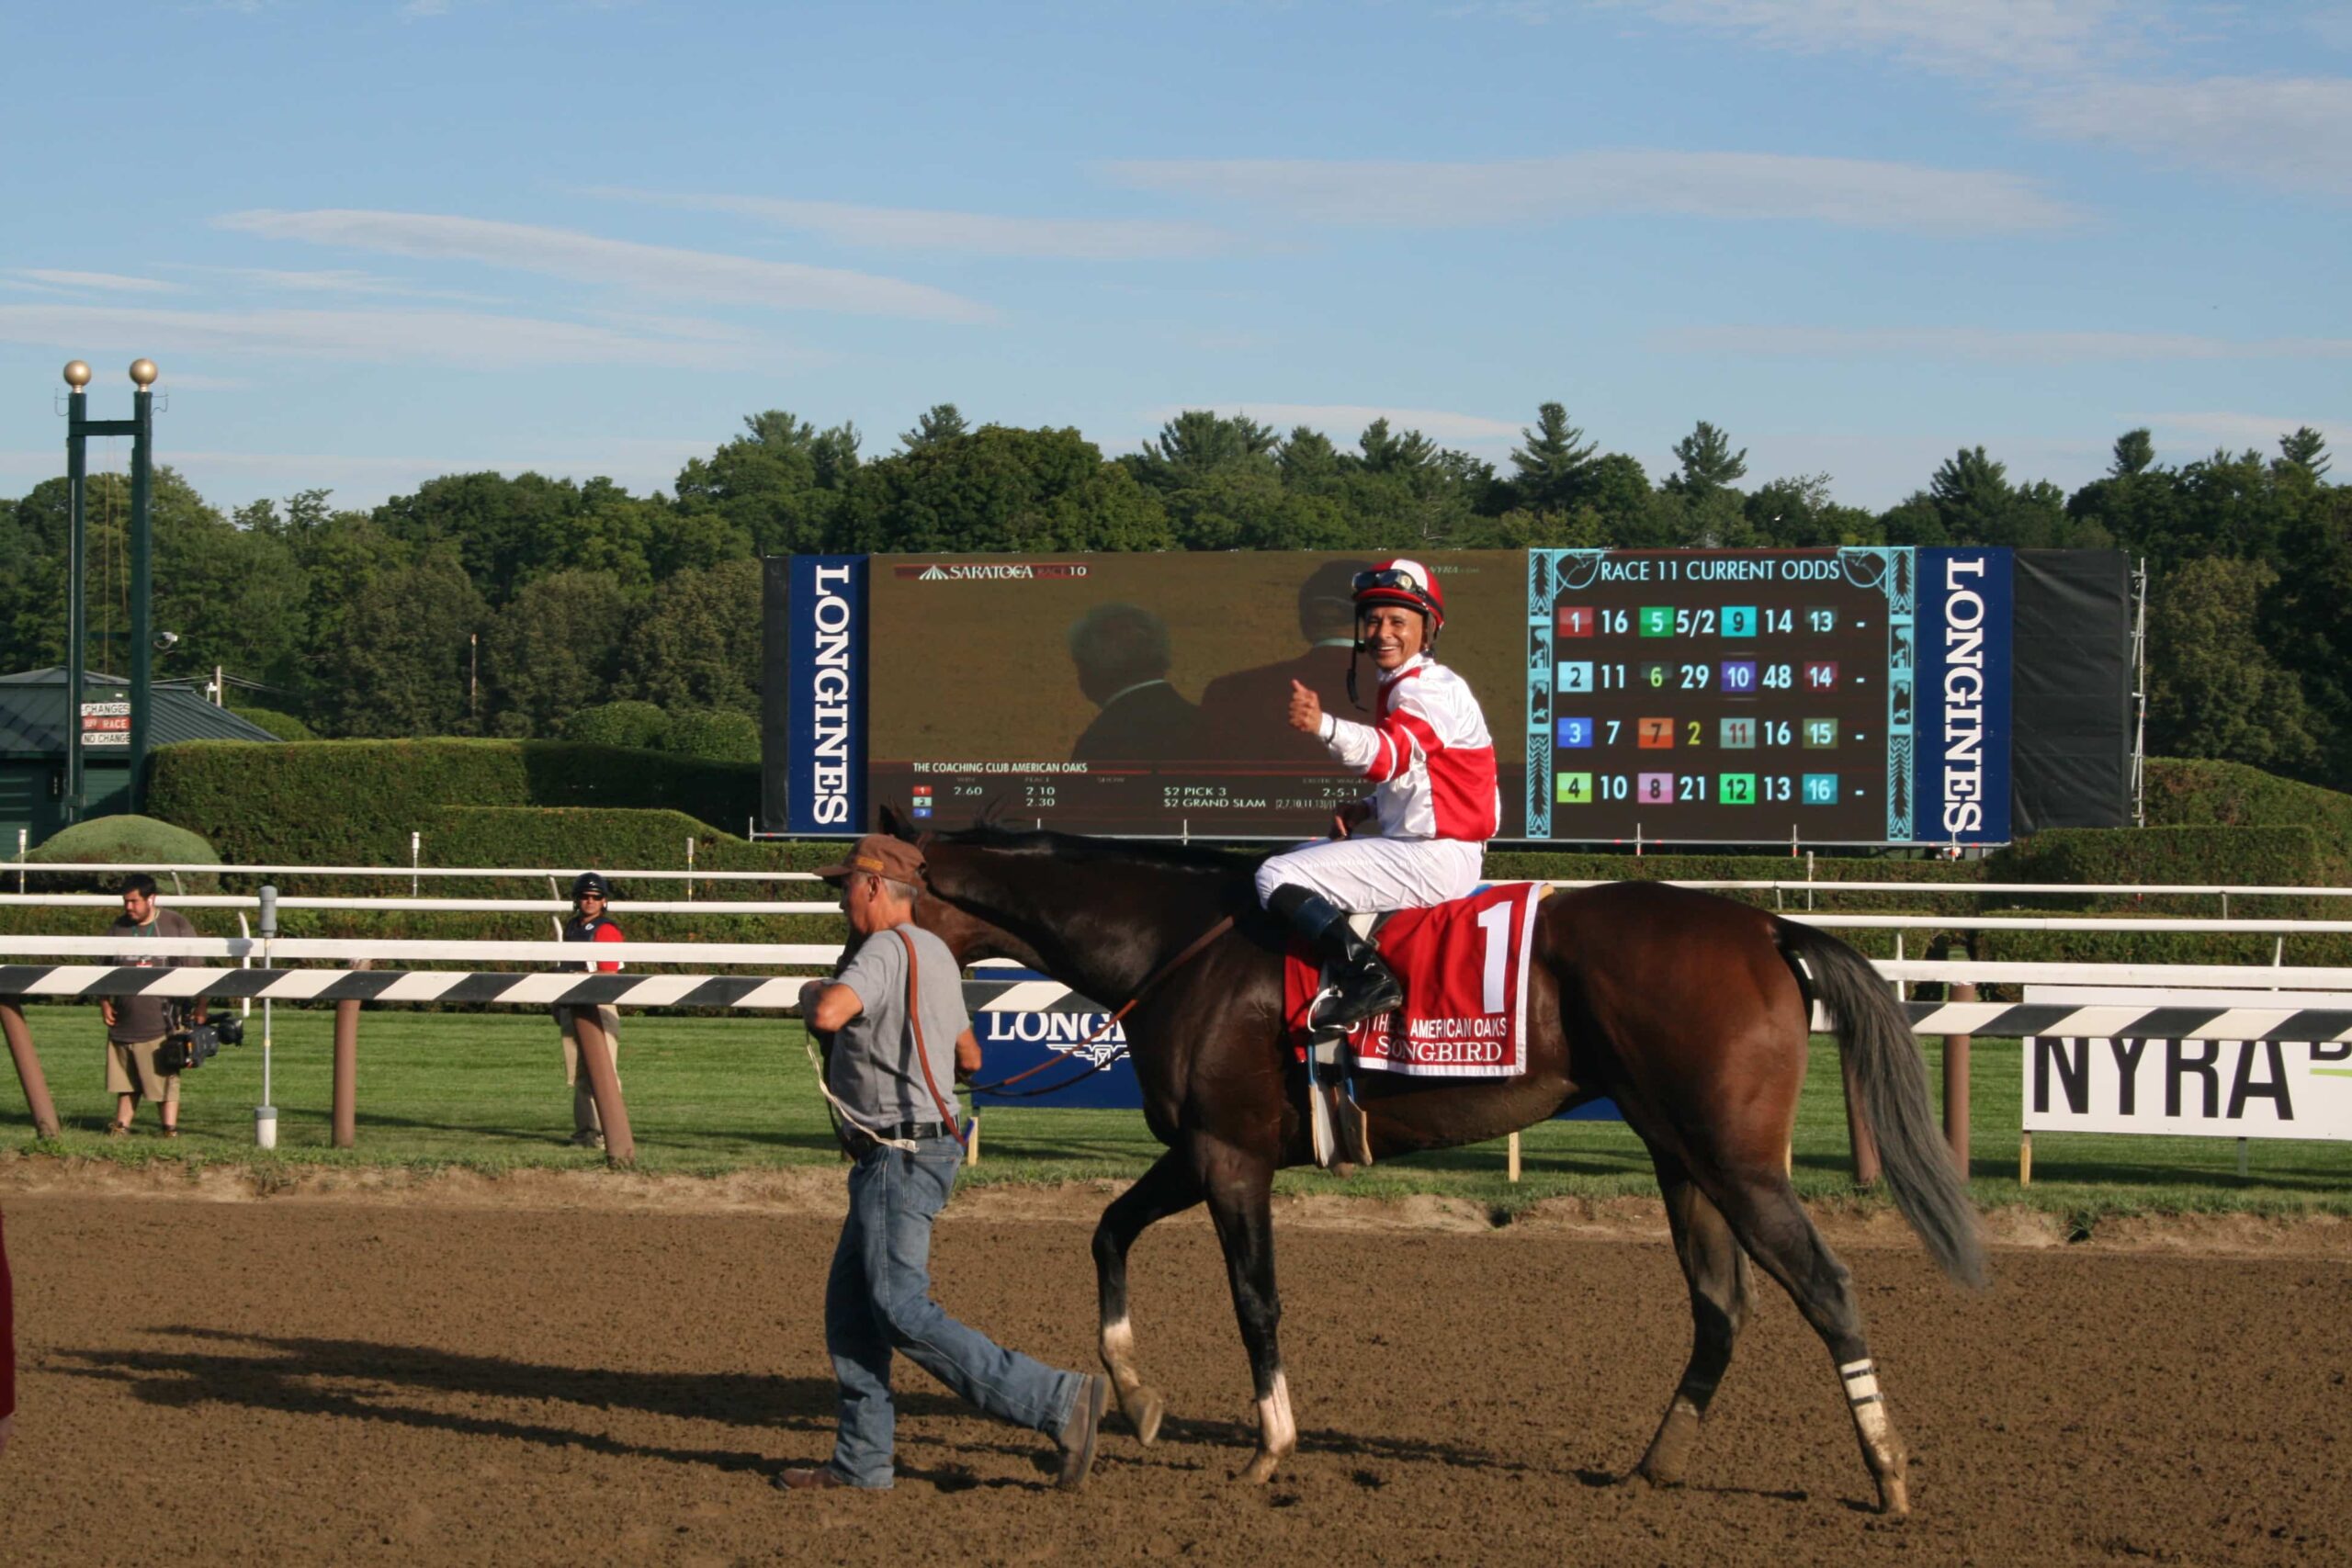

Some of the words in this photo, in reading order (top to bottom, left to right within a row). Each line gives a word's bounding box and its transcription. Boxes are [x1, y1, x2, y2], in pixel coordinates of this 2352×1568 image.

[949, 565, 1034, 580] SARATOGA
[1069, 565, 1088, 576] 10
[1600, 560, 1650, 581] RACE
[1658, 560, 1678, 581] 11
[1686, 559, 1776, 581] CURRENT
[1781, 559, 1840, 581] ODDS
[1571, 612, 1580, 632] 1
[1601, 610, 1628, 634] 16
[1651, 612, 1664, 632] 5
[1676, 610, 1715, 637] 5/2
[1732, 612, 1745, 632] 9
[1766, 610, 1793, 634] 14
[1811, 612, 1833, 632] 13
[1569, 667, 1582, 686] 2
[1601, 665, 1625, 688] 11
[1650, 667, 1663, 686] 6
[1680, 665, 1710, 688] 29
[1728, 667, 1749, 686] 10
[1762, 665, 1792, 688] 48
[1810, 667, 1832, 686] 14
[814, 565, 850, 825] LONGINES
[1942, 557, 1984, 833] LONGINES
[85, 704, 130, 714] CHANGES
[102, 719, 127, 729] RACE
[1569, 723, 1581, 743] 3
[1606, 721, 1621, 745] 7
[1650, 723, 1662, 743] 7
[1687, 721, 1702, 745] 2
[1729, 723, 1747, 743] 11
[1764, 721, 1792, 745] 16
[1809, 723, 1832, 743] 15
[84, 733, 96, 743] NO
[912, 762, 931, 773] THE
[932, 762, 984, 773] COACHING
[985, 762, 1010, 773] CLUB
[1011, 762, 1060, 773] AMERICAN
[1061, 762, 1088, 773] OAKS
[953, 786, 983, 795] 2.60
[1025, 786, 1056, 795] 2.10
[1163, 786, 1180, 796] $2
[1183, 786, 1214, 796] PICK
[1218, 786, 1227, 796] 3
[1322, 787, 1358, 797] 2-5-1
[1567, 778, 1580, 798] 4
[1600, 776, 1628, 800] 10
[1649, 778, 1661, 798] 8
[1679, 776, 1705, 800] 21
[1726, 778, 1747, 798] 12
[1764, 776, 1792, 800] 13
[1808, 778, 1831, 798] 16
[1025, 797, 1056, 807] 2.30
[1163, 798, 1179, 808] $2
[1182, 798, 1229, 807] GRAND
[1233, 798, 1266, 807] SLAM
[1477, 900, 1513, 1014] 1
[1409, 1017, 1471, 1040] AMERICAN
[1474, 1016, 1507, 1037] OAKS
[1374, 1034, 1503, 1063] SONGBIRD
[2032, 1035, 2295, 1122] NYRA
